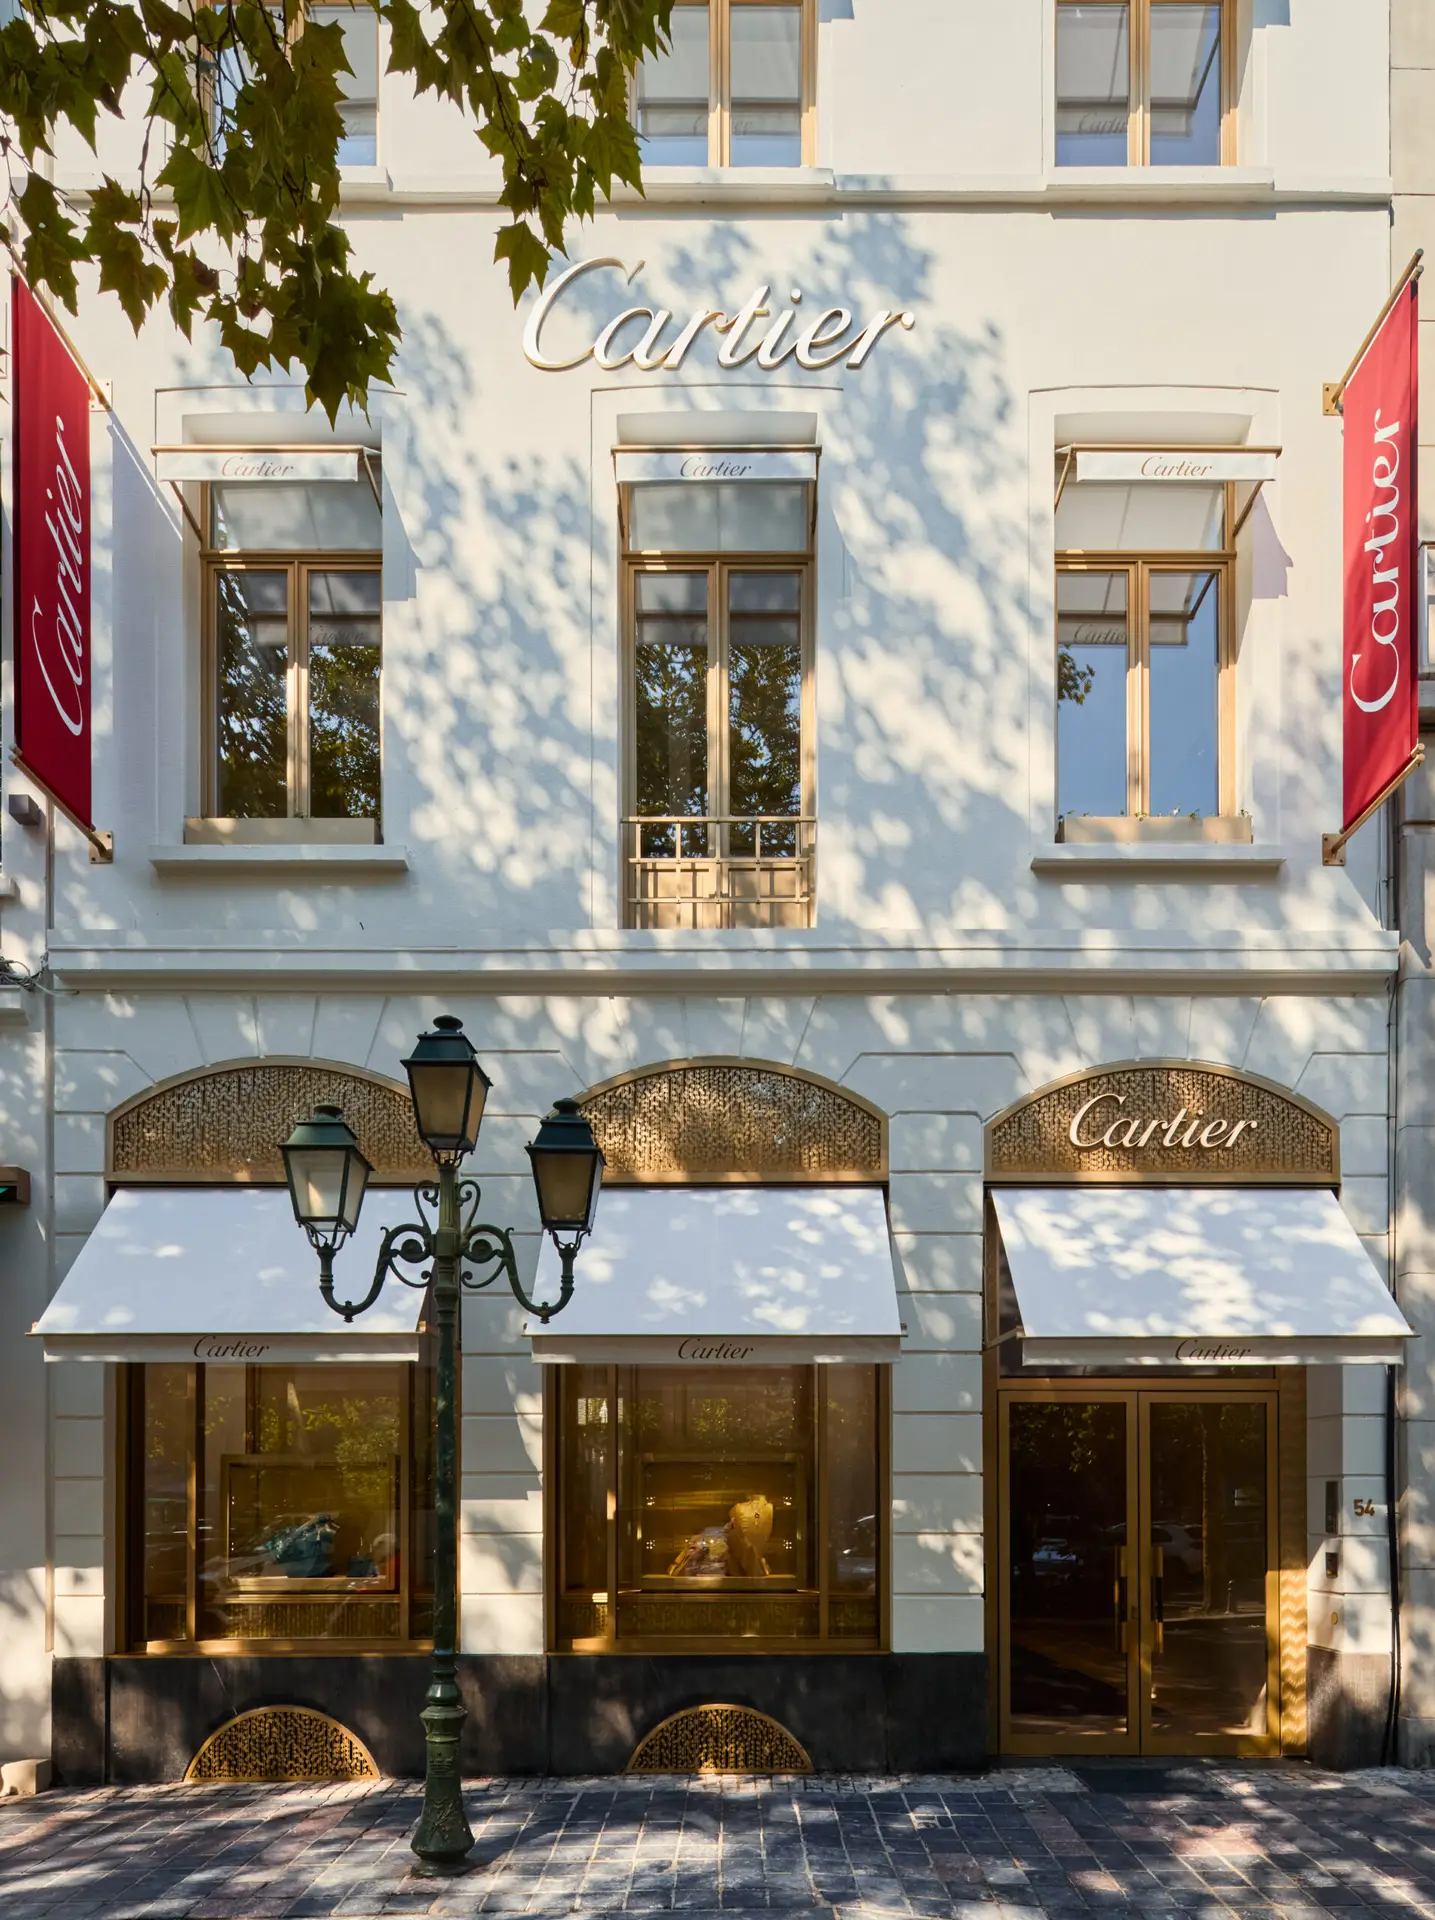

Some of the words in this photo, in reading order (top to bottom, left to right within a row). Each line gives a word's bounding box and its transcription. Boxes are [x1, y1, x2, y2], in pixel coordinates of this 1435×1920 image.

[522, 256, 915, 370] Cartier
[221, 456, 294, 477] Cartier
[680, 456, 752, 477] Cartier
[1141, 456, 1213, 477] Cartier
[1350, 407, 1400, 713] Cartier
[32, 414, 83, 736] Cartier
[1069, 1093, 1258, 1148] Cartier
[193, 1335, 270, 1358] Cartier
[678, 1338, 754, 1359] Cartier
[1175, 1339, 1251, 1361] Cartier
[1353, 1498, 1375, 1517] 54
